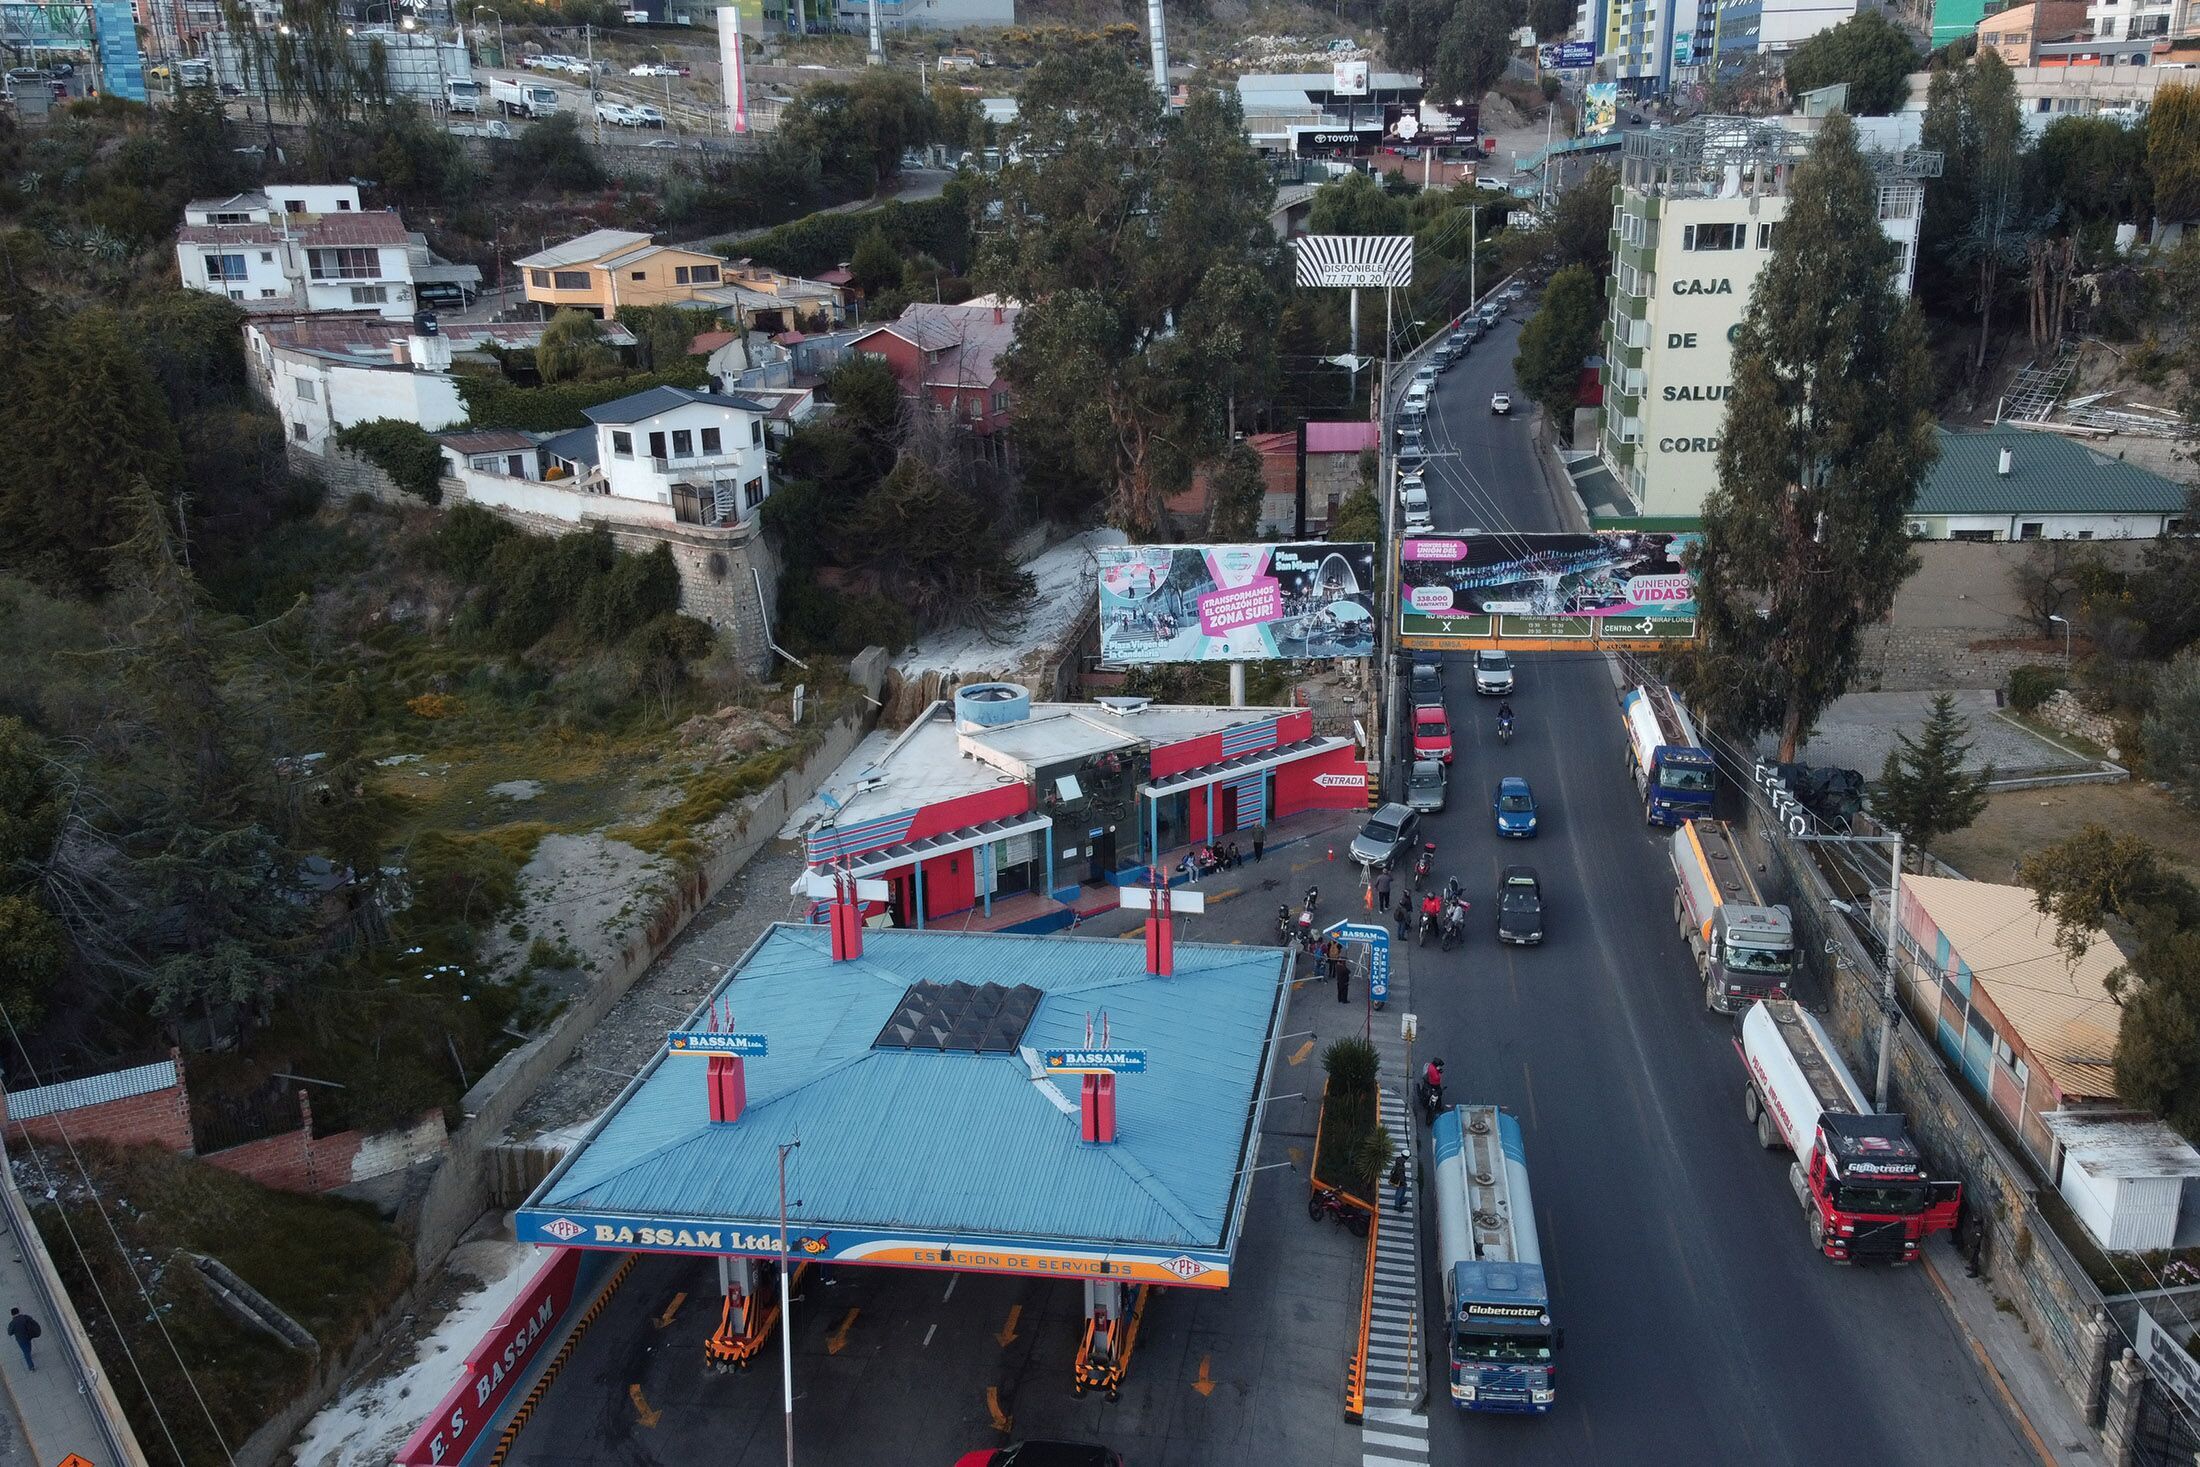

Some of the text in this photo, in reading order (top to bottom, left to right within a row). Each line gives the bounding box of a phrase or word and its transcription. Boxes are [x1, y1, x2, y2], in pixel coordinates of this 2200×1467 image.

[1327, 134, 1359, 142] TOYOTA
[1324, 264, 1383, 273] DISPONIBLE
[1326, 274, 1382, 282] 77 77 10 20
[1672, 279, 1732, 295] CAJA
[1668, 333, 1697, 349] DE
[1276, 560, 1319, 572] San Miguel
[1634, 579, 1689, 588] ¡UNIENDO
[1205, 595, 1274, 616] EL CORAZÓN DE LA
[1210, 603, 1273, 627] ZONA SUR!
[1322, 777, 1363, 785] ENTRADA
[1342, 931, 1377, 939] BASSAM
[689, 1036, 748, 1047] BASSAM
[1065, 1053, 1126, 1063] BASSAM
[550, 1223, 580, 1236] YPFB
[594, 1224, 722, 1248] BASSAM
[914, 1251, 1132, 1274] ESCION DE SERVICOS
[1170, 1259, 1200, 1275] YPFB
[1469, 1305, 1540, 1317] Globetrotter
[476, 1295, 553, 1408] BASSAM
